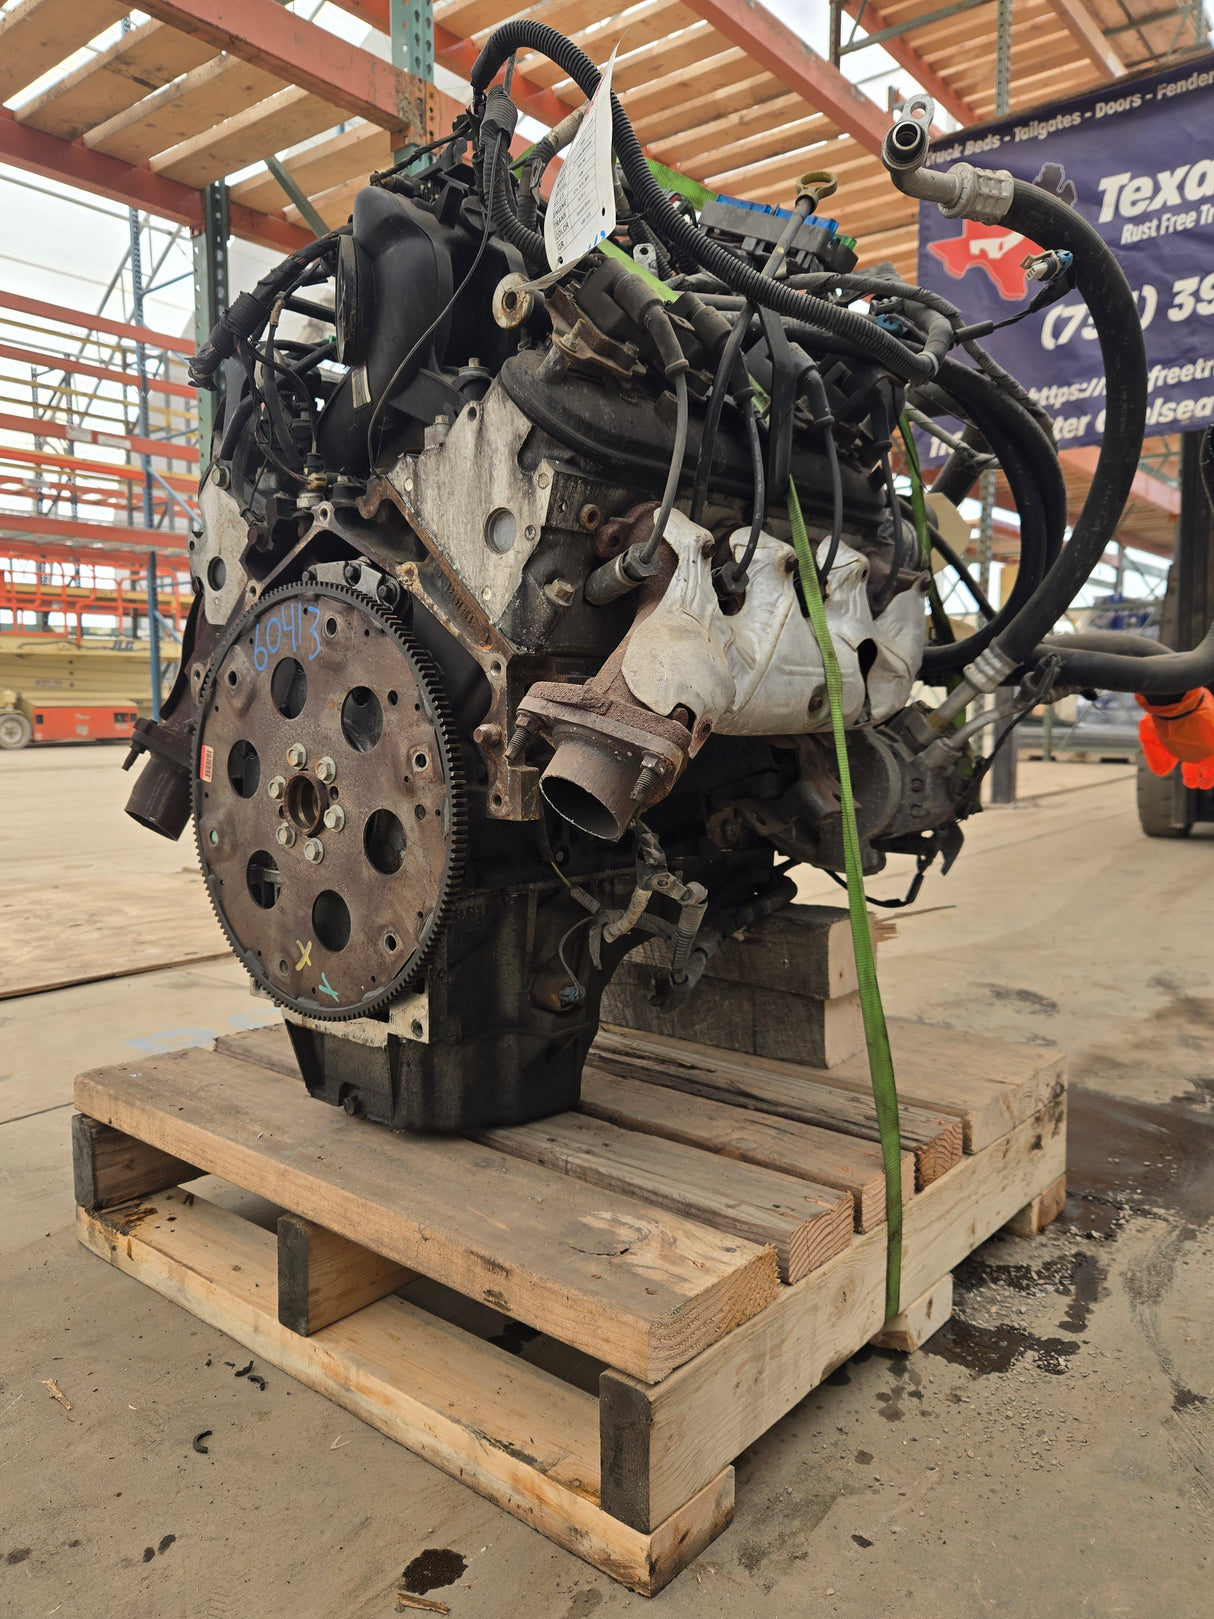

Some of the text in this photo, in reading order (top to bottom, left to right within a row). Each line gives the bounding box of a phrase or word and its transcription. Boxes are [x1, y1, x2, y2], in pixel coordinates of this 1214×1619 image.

[926, 143, 964, 167] Truck
[963, 133, 1002, 156] Beds
[1013, 110, 1082, 143] Tailgates
[1095, 92, 1142, 119] Doors
[1156, 70, 1214, 100] Fender
[1098, 159, 1214, 224] Texa
[554, 211, 567, 229] TRANS
[555, 221, 569, 240] COLOR
[1120, 222, 1159, 246] Rust
[1160, 210, 1197, 236] Free
[254, 602, 321, 671] 60413
